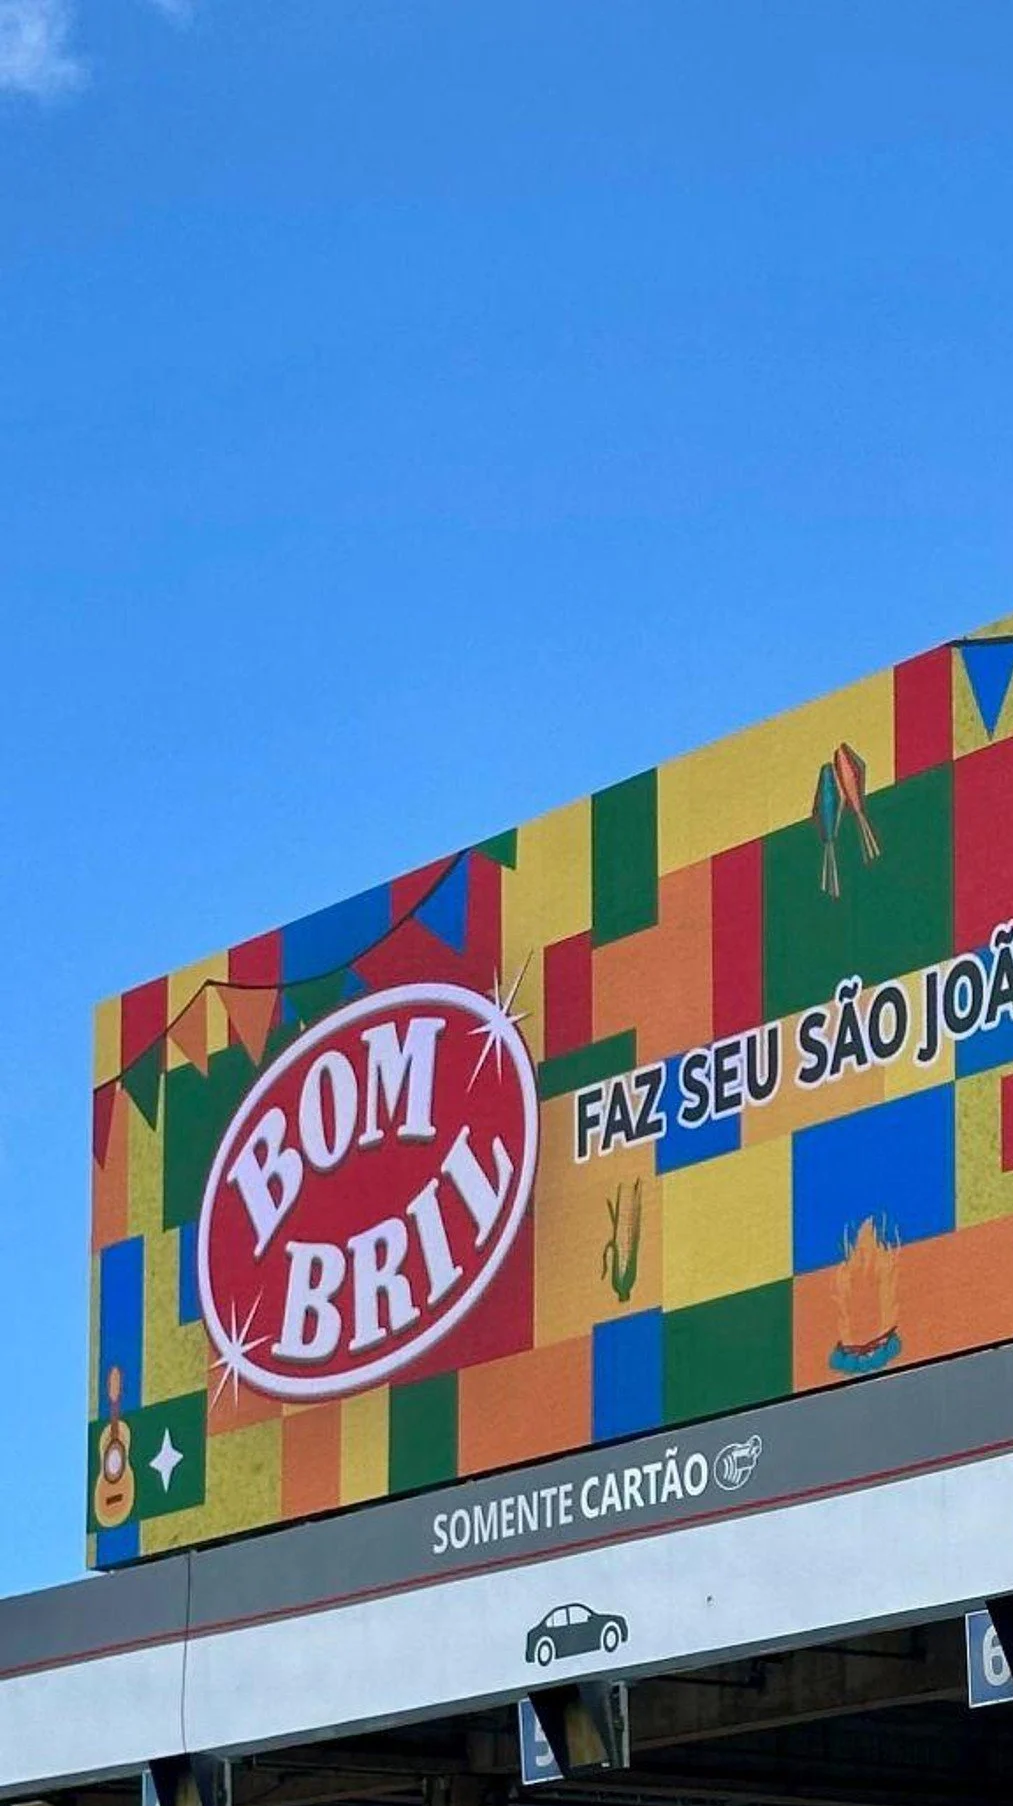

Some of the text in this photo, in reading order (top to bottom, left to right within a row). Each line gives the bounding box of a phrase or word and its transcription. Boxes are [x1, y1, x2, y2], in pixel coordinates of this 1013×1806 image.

[227, 1016, 446, 1260] BOM
[575, 1064, 667, 1160] FAZ
[680, 1026, 779, 1122] SEU
[799, 981, 906, 1083] SÃO
[272, 1125, 516, 1363] BRIL
[432, 1446, 709, 1554] SOMENTE CARTÃO
